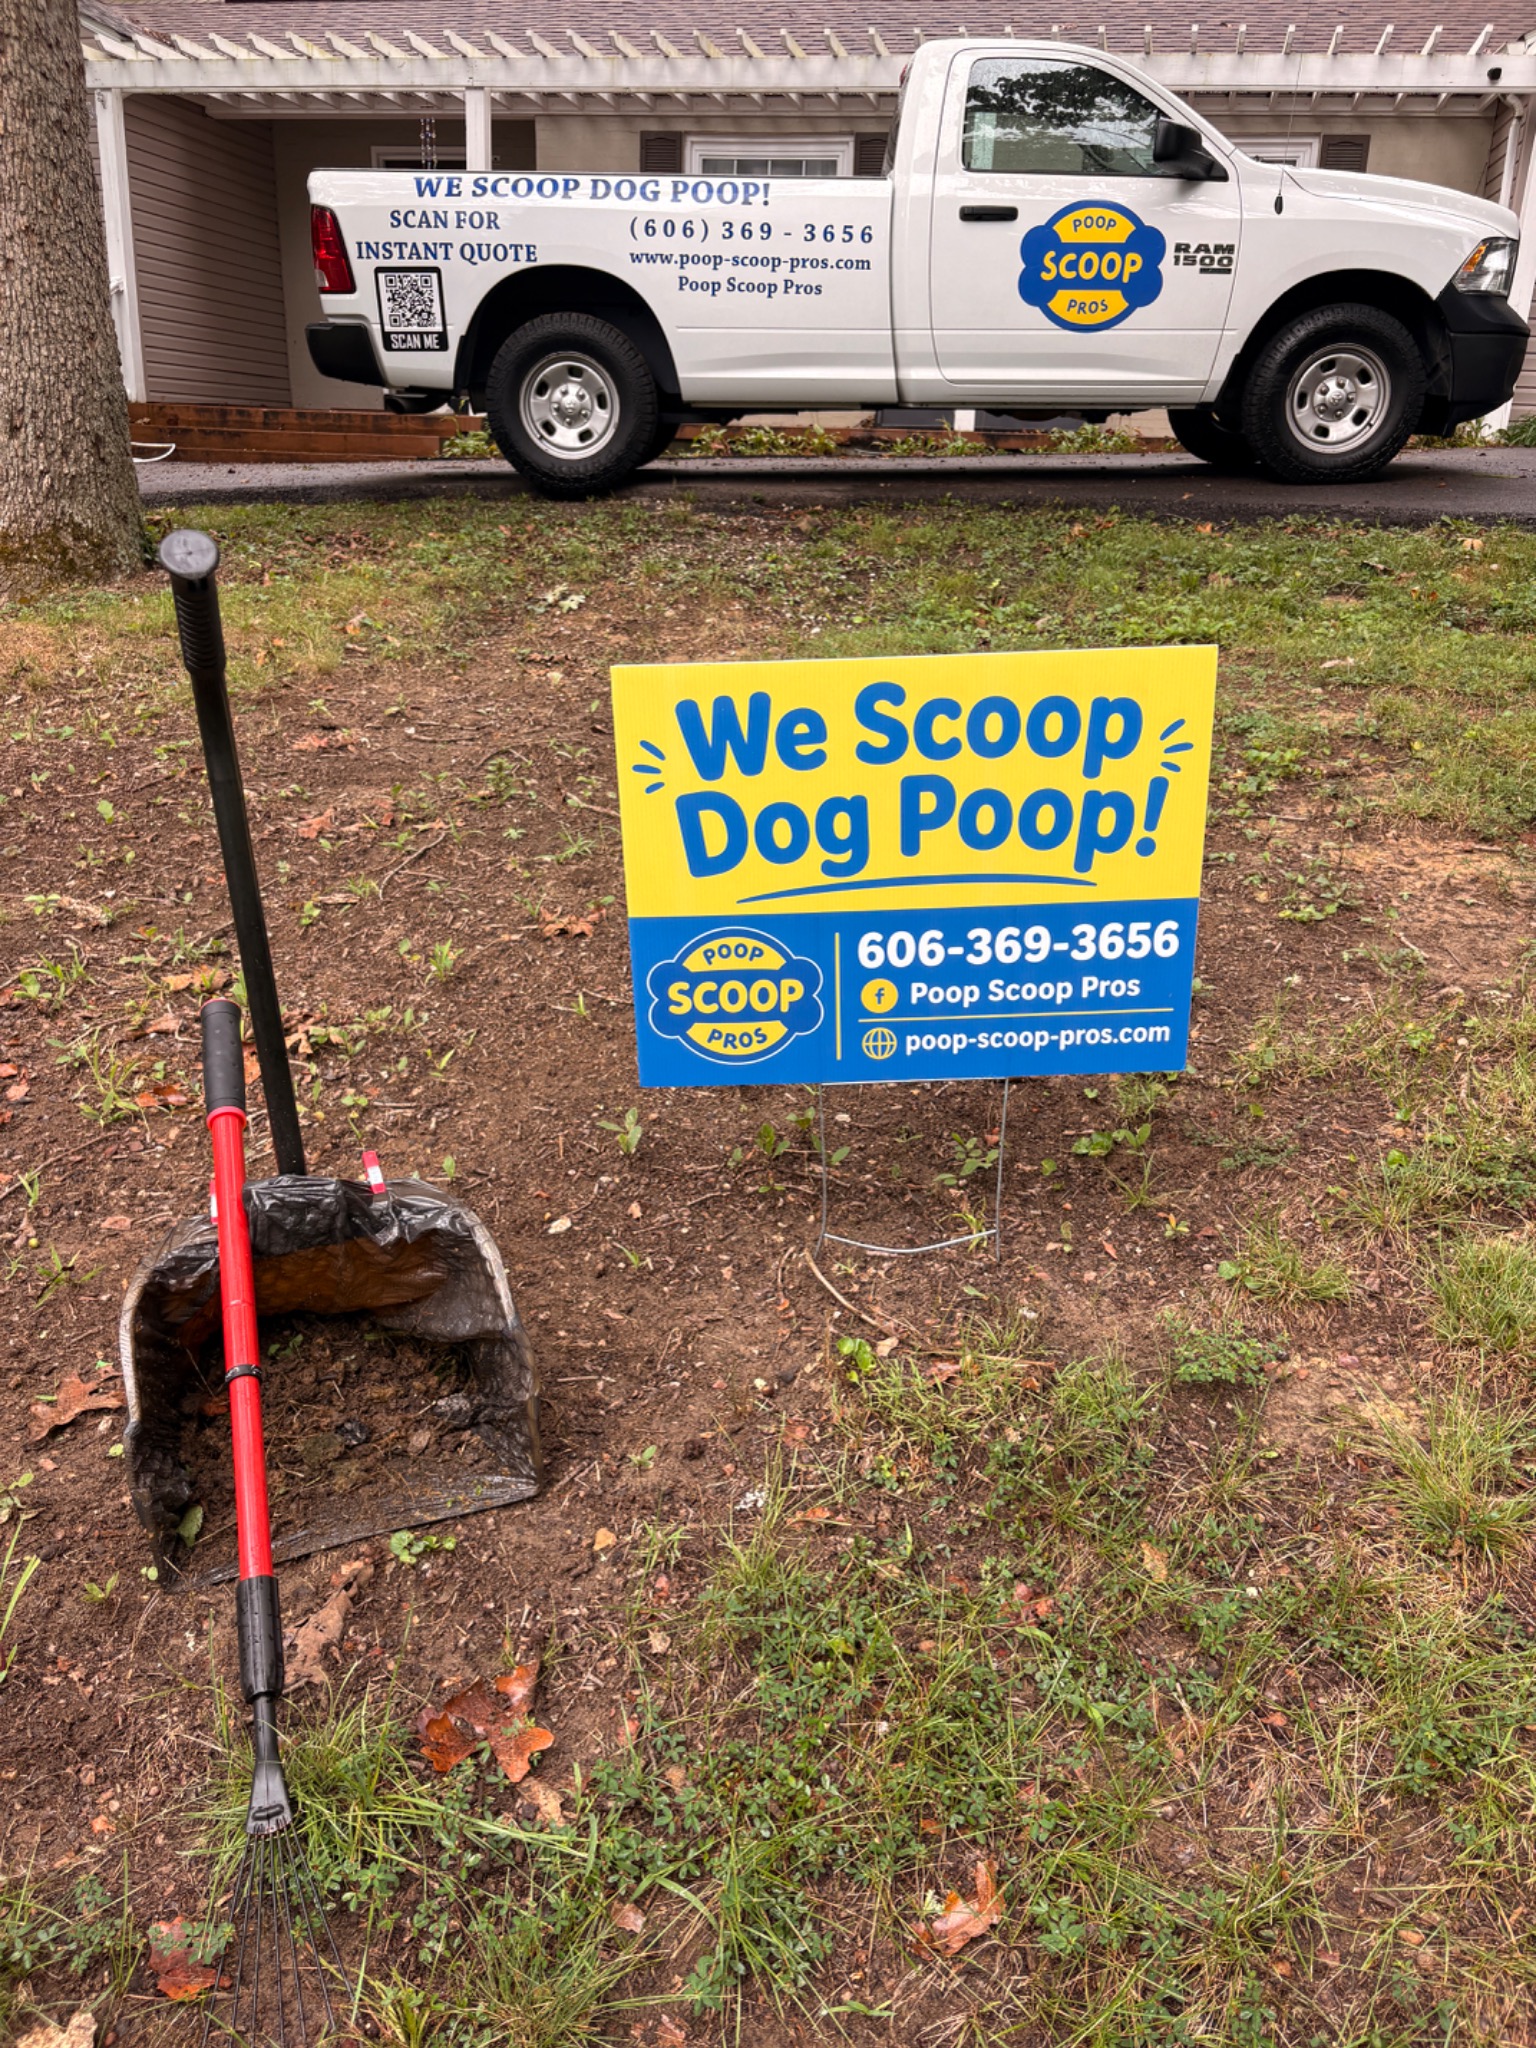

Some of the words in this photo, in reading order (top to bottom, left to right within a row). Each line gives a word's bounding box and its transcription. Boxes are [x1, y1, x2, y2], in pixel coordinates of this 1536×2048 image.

[414, 176, 463, 198] WE
[471, 177, 581, 198] SCOOP
[589, 179, 661, 202] DOG
[670, 181, 771, 206] POOP!
[389, 211, 450, 230] SCAN
[455, 211, 501, 230] FOR
[629, 216, 711, 244] (606)
[721, 222, 774, 242] 369
[803, 223, 874, 244] 3656
[1072, 215, 1118, 233] POOP
[356, 241, 454, 261] INSTANT
[460, 243, 538, 264] QUOTE
[1174, 242, 1236, 255] RAM
[629, 251, 872, 272] www.poop-scoop-pros.com
[1040, 250, 1143, 284] SCOOP
[1173, 254, 1235, 268] 1500
[677, 276, 723, 297] Poop
[726, 278, 779, 299] Scoop
[783, 280, 824, 296] Pros
[1066, 298, 1109, 316] PROS
[390, 333, 423, 351] SCAN
[423, 333, 441, 350] ME
[675, 691, 828, 782] We
[854, 682, 1143, 779] Scoop
[675, 790, 870, 878] Dog
[900, 774, 1170, 873] Poop!
[702, 943, 765, 966] POOP
[857, 920, 1180, 969] 606-369-3656
[667, 979, 804, 1015] SCOOP
[910, 981, 980, 1008] Poop
[988, 978, 1073, 1005] Scoop
[1081, 975, 1142, 999] Pros
[706, 1027, 768, 1050] PROS
[905, 1024, 1171, 1057] poop-scoop-pros.com
